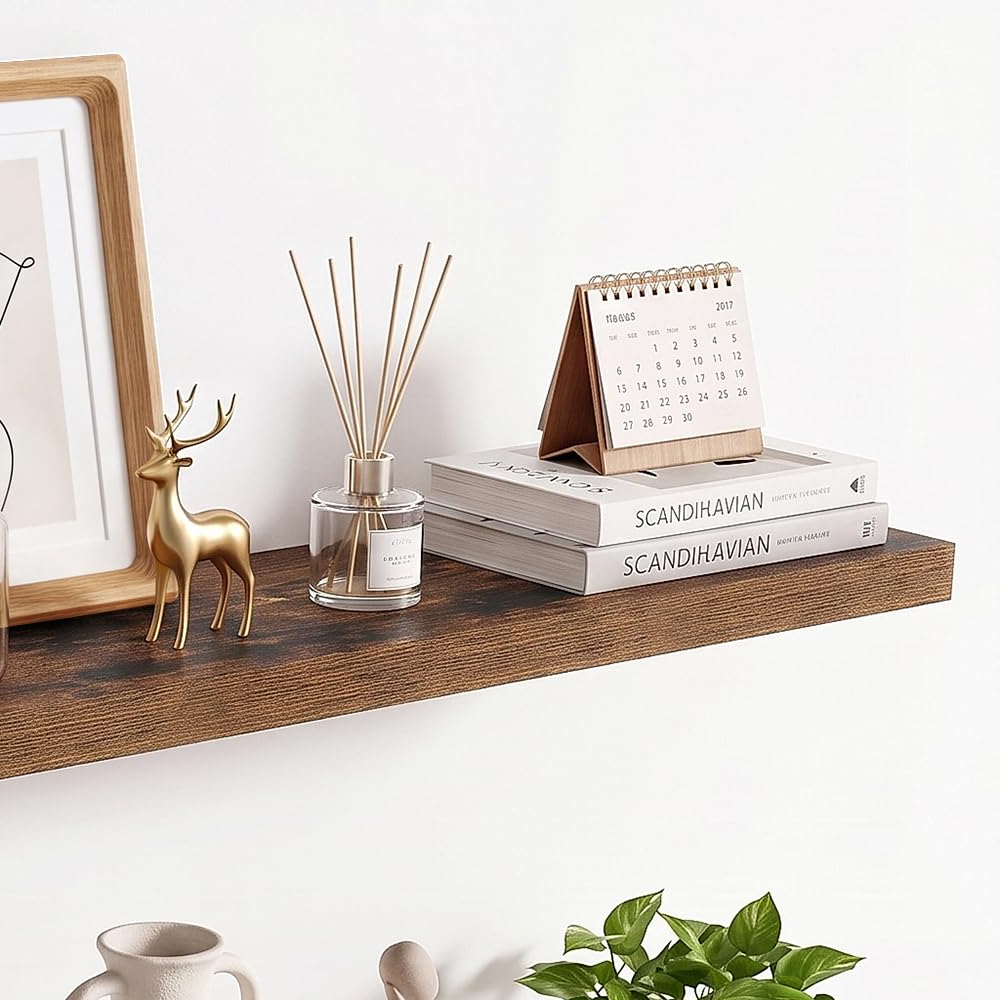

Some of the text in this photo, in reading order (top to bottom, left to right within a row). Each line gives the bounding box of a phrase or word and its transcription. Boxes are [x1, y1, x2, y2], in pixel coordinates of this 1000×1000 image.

[715, 300, 734, 312] 2017
[692, 356, 704, 366] 10
[712, 353, 723, 363] 11
[732, 350, 742, 361] 12
[636, 381, 648, 391] 14
[656, 378, 667, 389] 15
[676, 376, 687, 386] 16
[695, 373, 705, 384] 17
[715, 371, 726, 381] 18
[734, 368, 744, 378] 19
[619, 386, 748, 413] 20 21 22 23 24 25 26
[622, 412, 693, 431] 27 28 29 30
